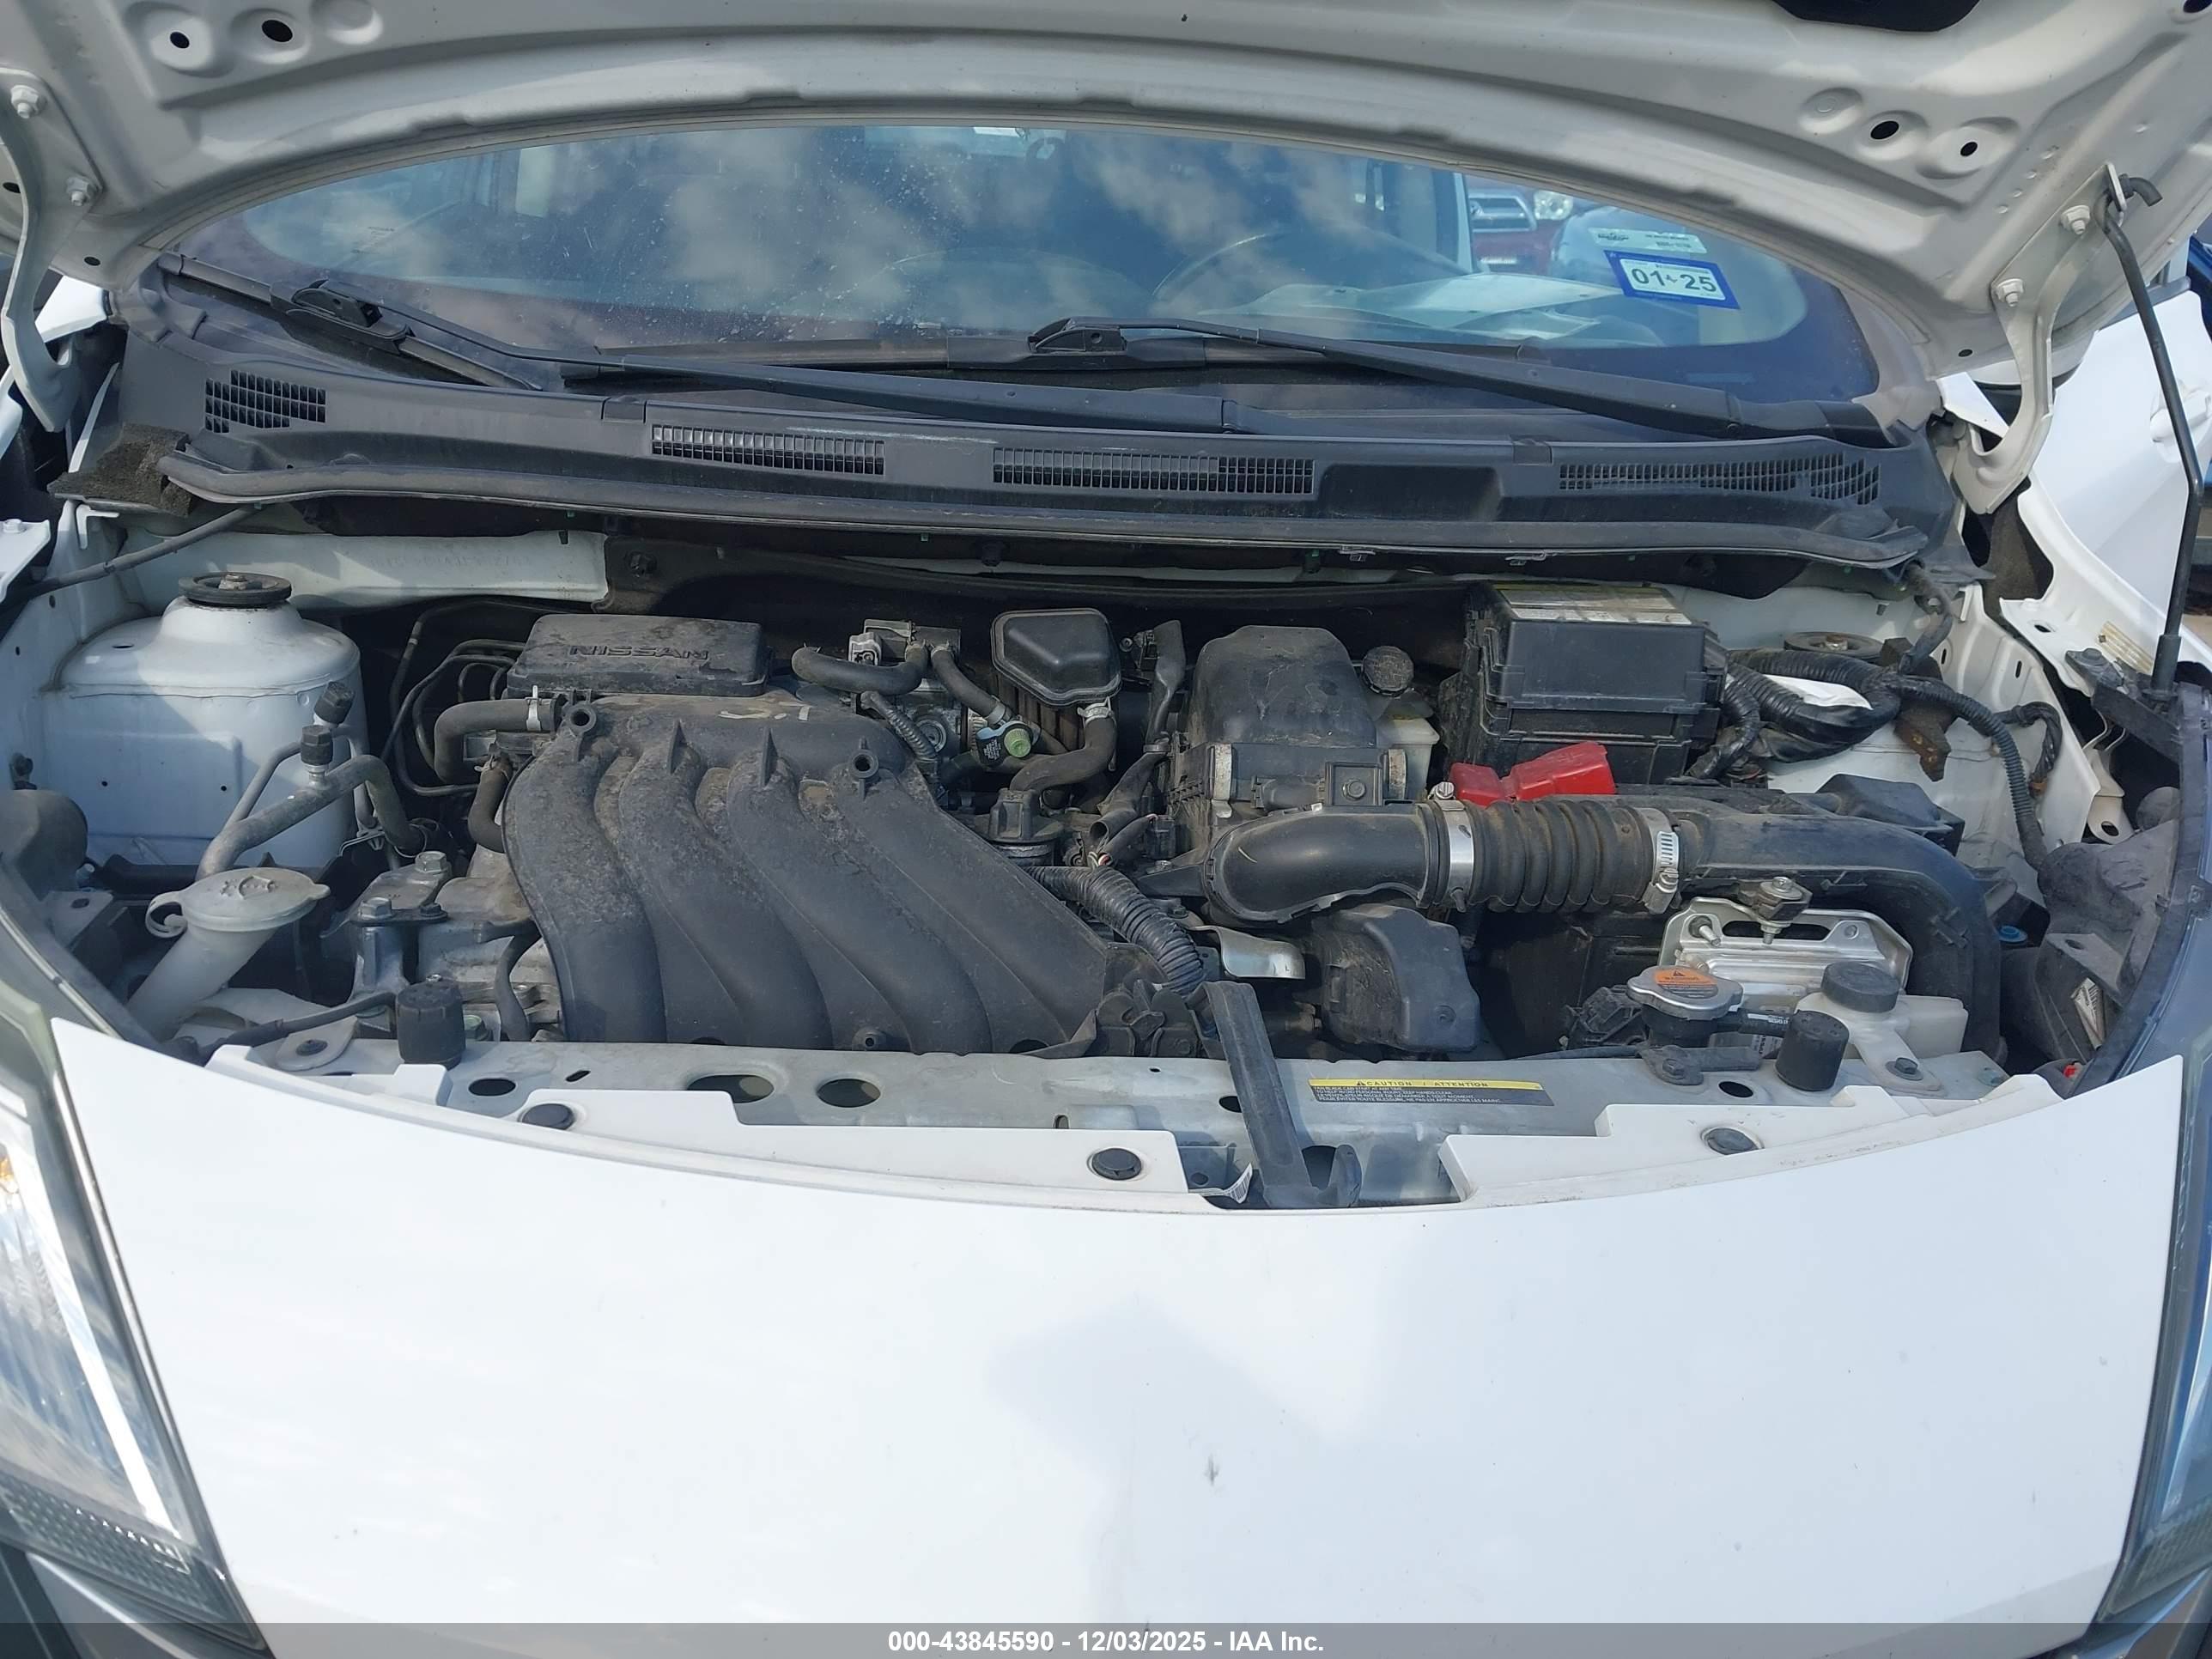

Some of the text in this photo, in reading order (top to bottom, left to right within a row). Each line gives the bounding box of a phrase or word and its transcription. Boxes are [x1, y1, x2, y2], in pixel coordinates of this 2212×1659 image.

[1632, 268, 1666, 287] 01
[1680, 273, 1717, 293] 25
[568, 644, 709, 660] NISSAN
